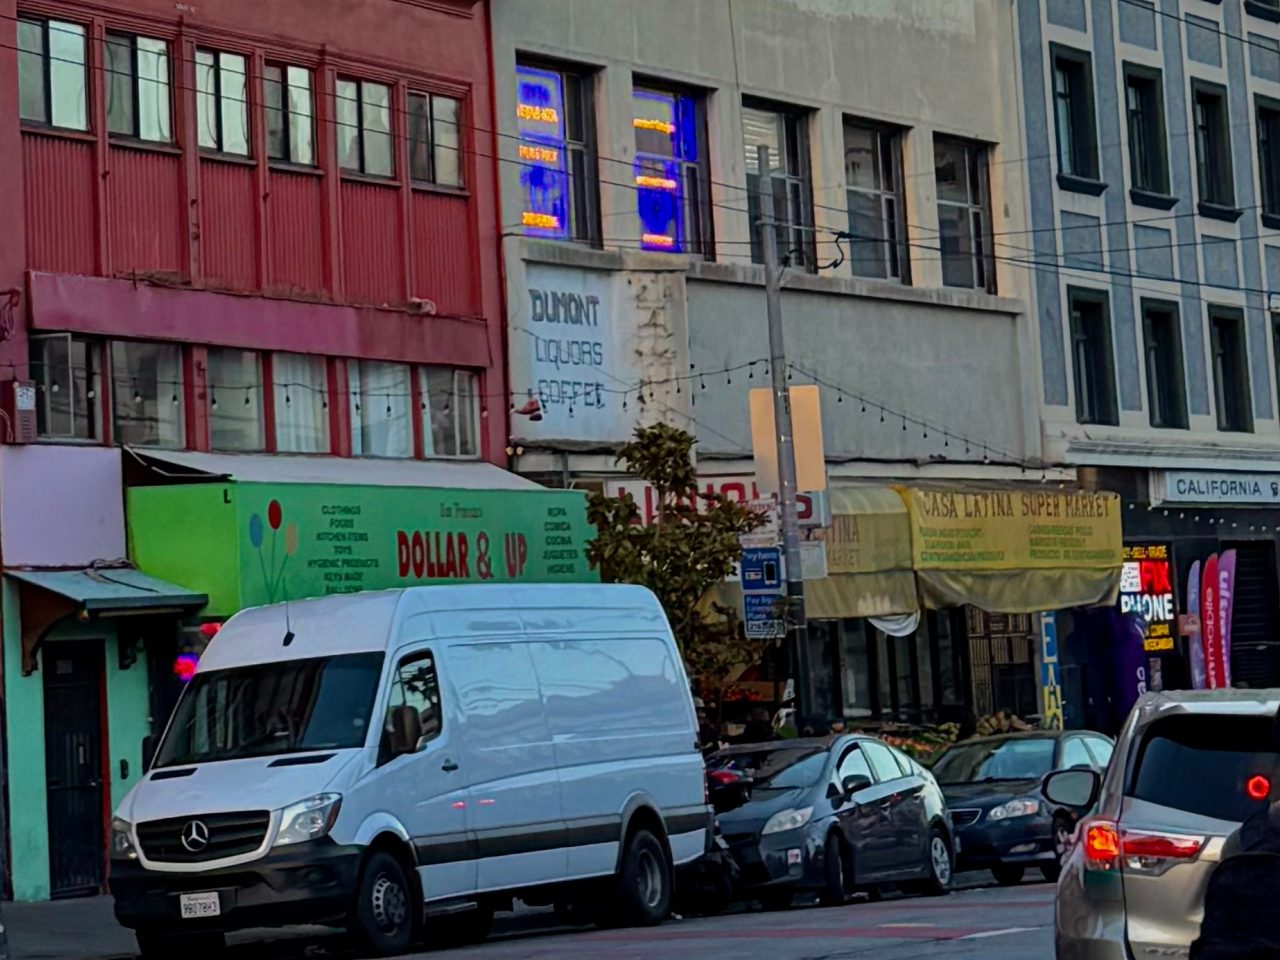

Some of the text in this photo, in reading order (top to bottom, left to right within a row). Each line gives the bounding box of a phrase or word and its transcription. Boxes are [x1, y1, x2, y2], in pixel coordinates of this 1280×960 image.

[528, 288, 600, 327] DUMONT
[535, 337, 604, 370] LIQUORS
[1176, 478, 1262, 496] CALIFORNIA
[923, 492, 1110, 518] CASA LATINA SUPER MARKET
[397, 530, 527, 579] DOLLAR & UP
[1142, 561, 1172, 594] FIX
[1121, 593, 1174, 621] PHONE
